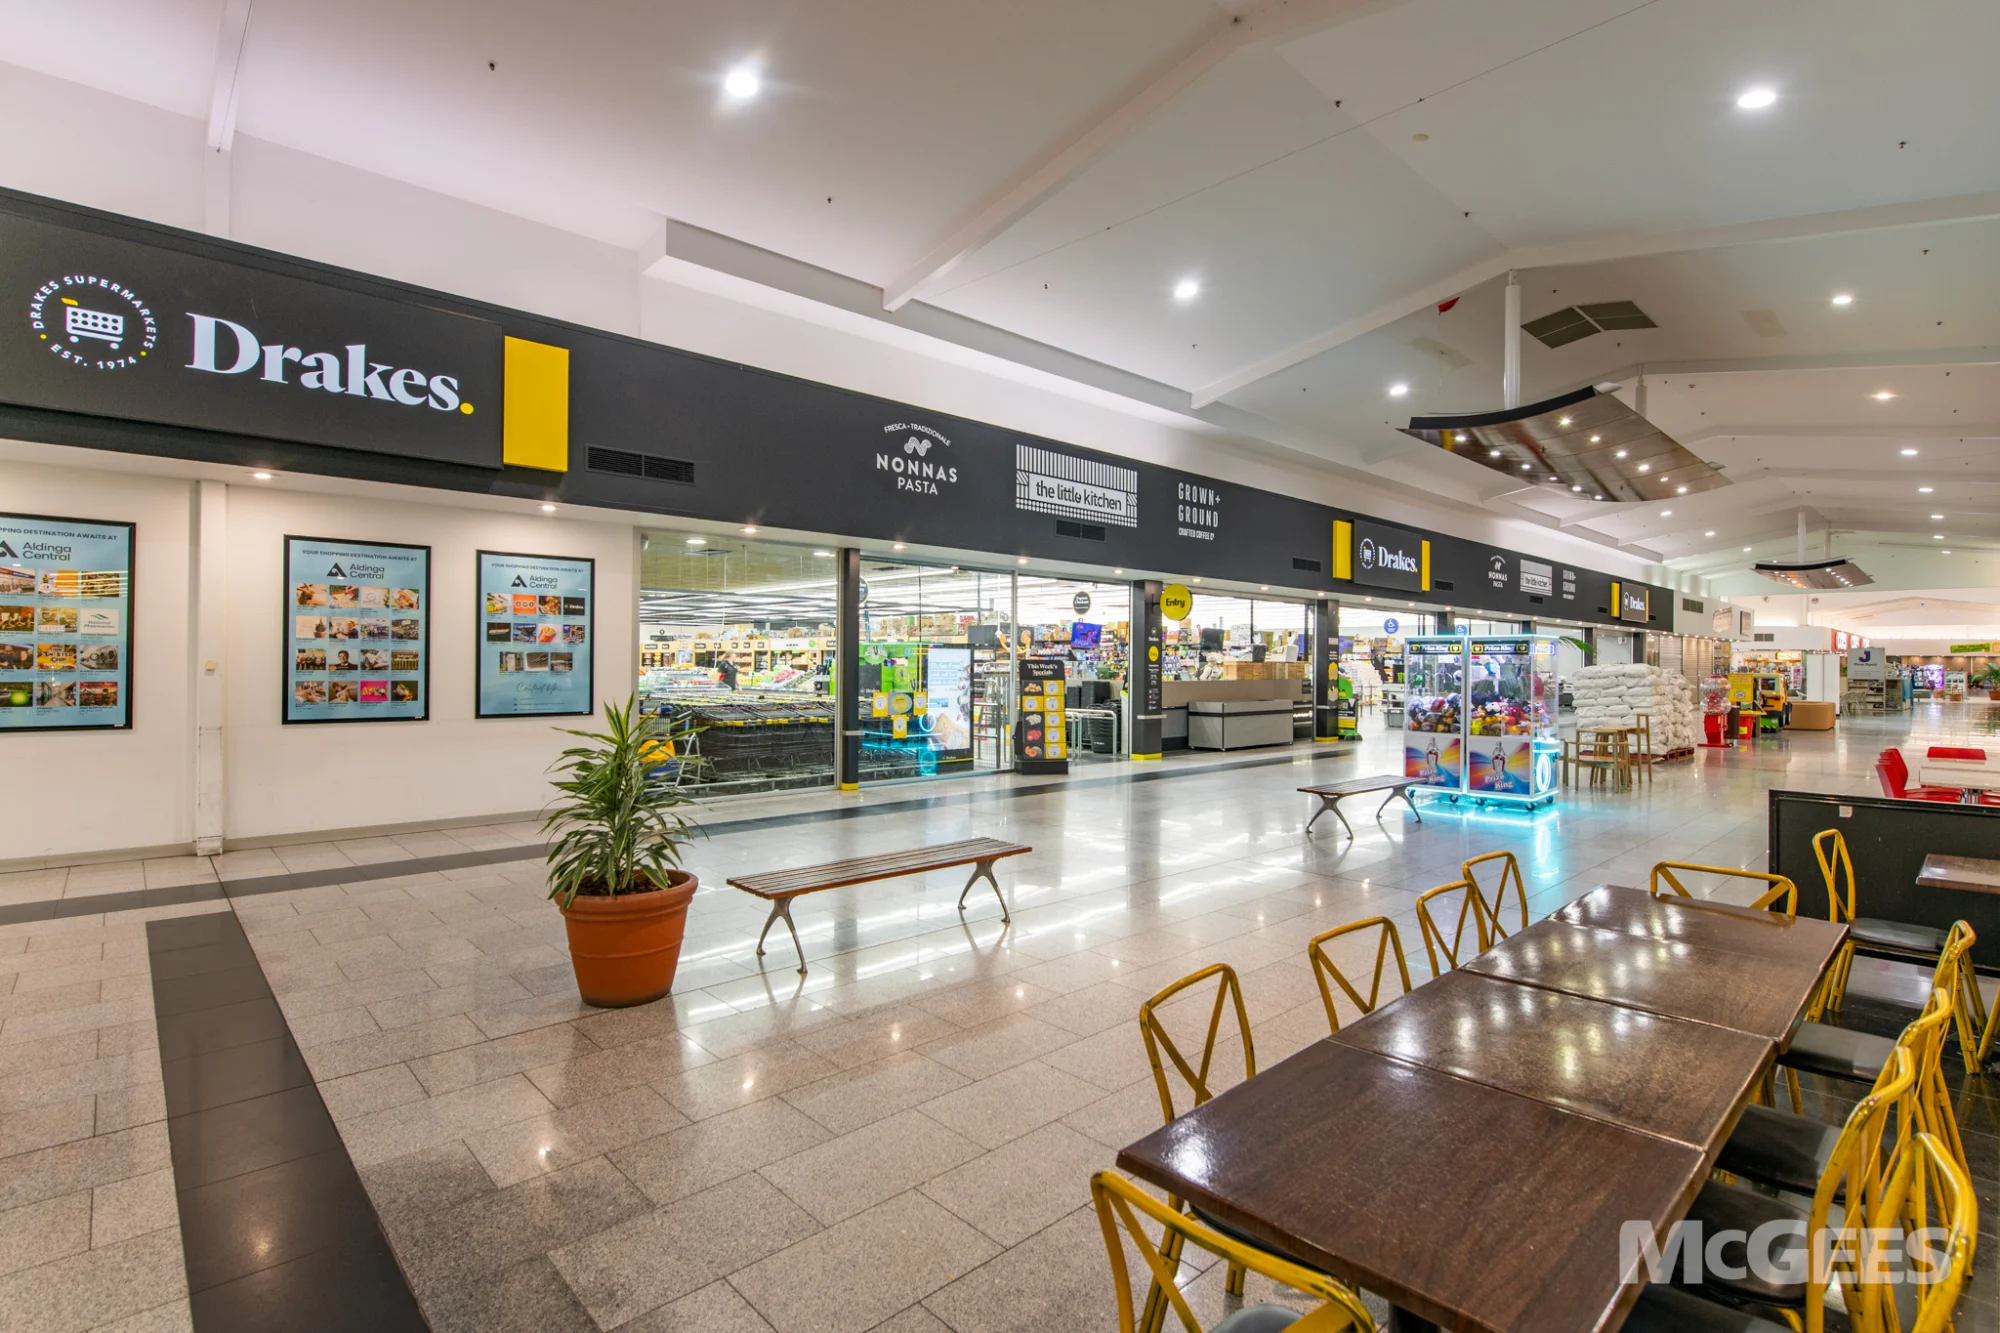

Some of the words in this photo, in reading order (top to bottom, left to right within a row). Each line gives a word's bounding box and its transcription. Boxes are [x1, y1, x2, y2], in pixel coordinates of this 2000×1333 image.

[30, 280, 60, 329] DRAKES
[63, 275, 157, 349] SUPERMARKETS
[50, 343, 88, 367] EST.
[96, 356, 136, 369] 1974
[884, 422, 907, 434] FRESCA
[910, 422, 951, 447] TRADIZIONALE
[876, 452, 958, 483] NONNAS
[898, 476, 938, 495] PASTA
[1036, 480, 1055, 499] the
[1057, 483, 1082, 504] little
[1084, 488, 1122, 512] kitchen
[1178, 504, 1218, 528] GROUND
[24, 528, 75, 538] DESTINATION
[1196, 530, 1210, 540] COFFEE
[22, 542, 72, 554] Aldinga
[22, 550, 70, 560] Central
[350, 564, 385, 572] Aldinga
[350, 570, 384, 579] Central
[529, 575, 558, 584] Aldinga
[1166, 598, 1185, 608] Entry
[1485, 774, 1504, 782] Prize
[1495, 781, 1513, 790] King
